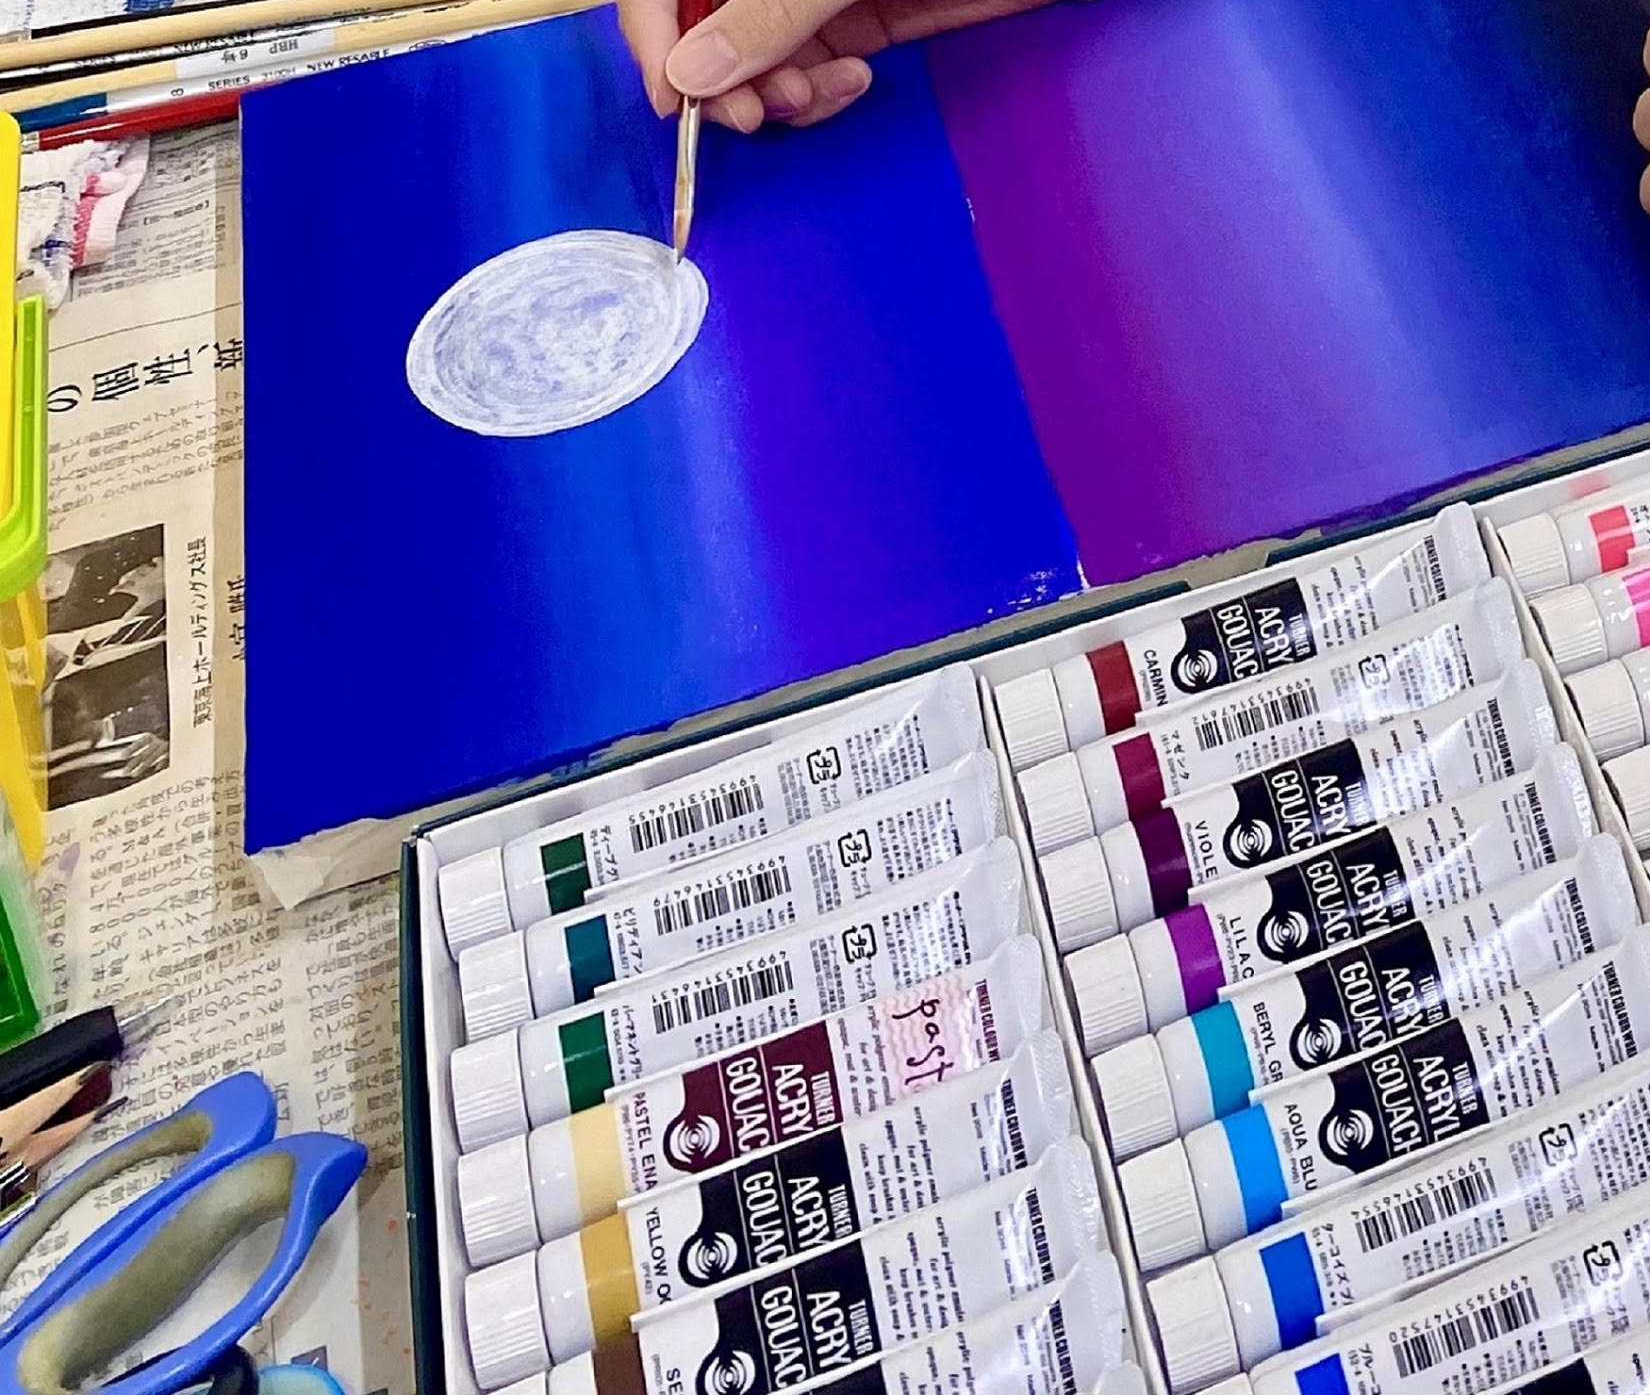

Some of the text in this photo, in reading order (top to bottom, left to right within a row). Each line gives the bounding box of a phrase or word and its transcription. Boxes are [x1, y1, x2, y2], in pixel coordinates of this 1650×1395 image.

[207, 74, 250, 90] SERIES
[306, 59, 334, 72] NEW
[1422, 534, 1439, 564] TURNER
[1215, 602, 1261, 681] GOUAC
[1252, 602, 1295, 668] ACRY
[1285, 612, 1312, 657] TURNER
[1141, 648, 1170, 707] CARMIN
[1485, 697, 1512, 760] TURNER COLOUR
[812, 754, 834, 784] プラ
[1269, 768, 1318, 853] GOUAC
[1309, 770, 1353, 840] ACRY
[1523, 781, 1552, 847] TURNER COLOUR
[844, 838, 864, 865] プラ
[1191, 819, 1220, 878] VIOLE
[1379, 869, 1409, 918] TURNER
[1563, 877, 1593, 947] TURNER COLOUR
[847, 932, 868, 962] プラ
[1226, 916, 1258, 980] LILAC
[973, 978, 998, 1049] TURNER COLOUR
[1251, 1001, 1278, 1054] BERYL
[1336, 959, 1389, 1051] GOUAC
[1379, 962, 1425, 1037] ACRY
[1415, 973, 1446, 1024] TURNER
[1600, 960, 1632, 1033] TURNER COLOUR
[628, 1091, 654, 1149] PASTEL
[722, 1056, 773, 1152] GOUAC
[769, 1060, 815, 1137] ACRY
[807, 1071, 837, 1125] TURNER
[997, 1078, 1024, 1152] TURNER COLOUR
[1367, 1051, 1425, 1157] GOUACH
[1410, 1050, 1465, 1143] ACRYL
[1448, 1061, 1480, 1115] TURNER
[1283, 1101, 1321, 1192] AQUA BLU
[641, 1206, 670, 1278] YELLOW
[738, 1170, 790, 1267] GOUAC
[785, 1173, 831, 1251] ACRY
[825, 1183, 854, 1239] TURNER
[1023, 1187, 1050, 1264] TURNER COLOUR
[757, 1284, 810, 1389] GOUAC
[804, 1288, 853, 1369] ACRY
[846, 1299, 875, 1355] TURNER
[1045, 1299, 1066, 1339] TURNER
